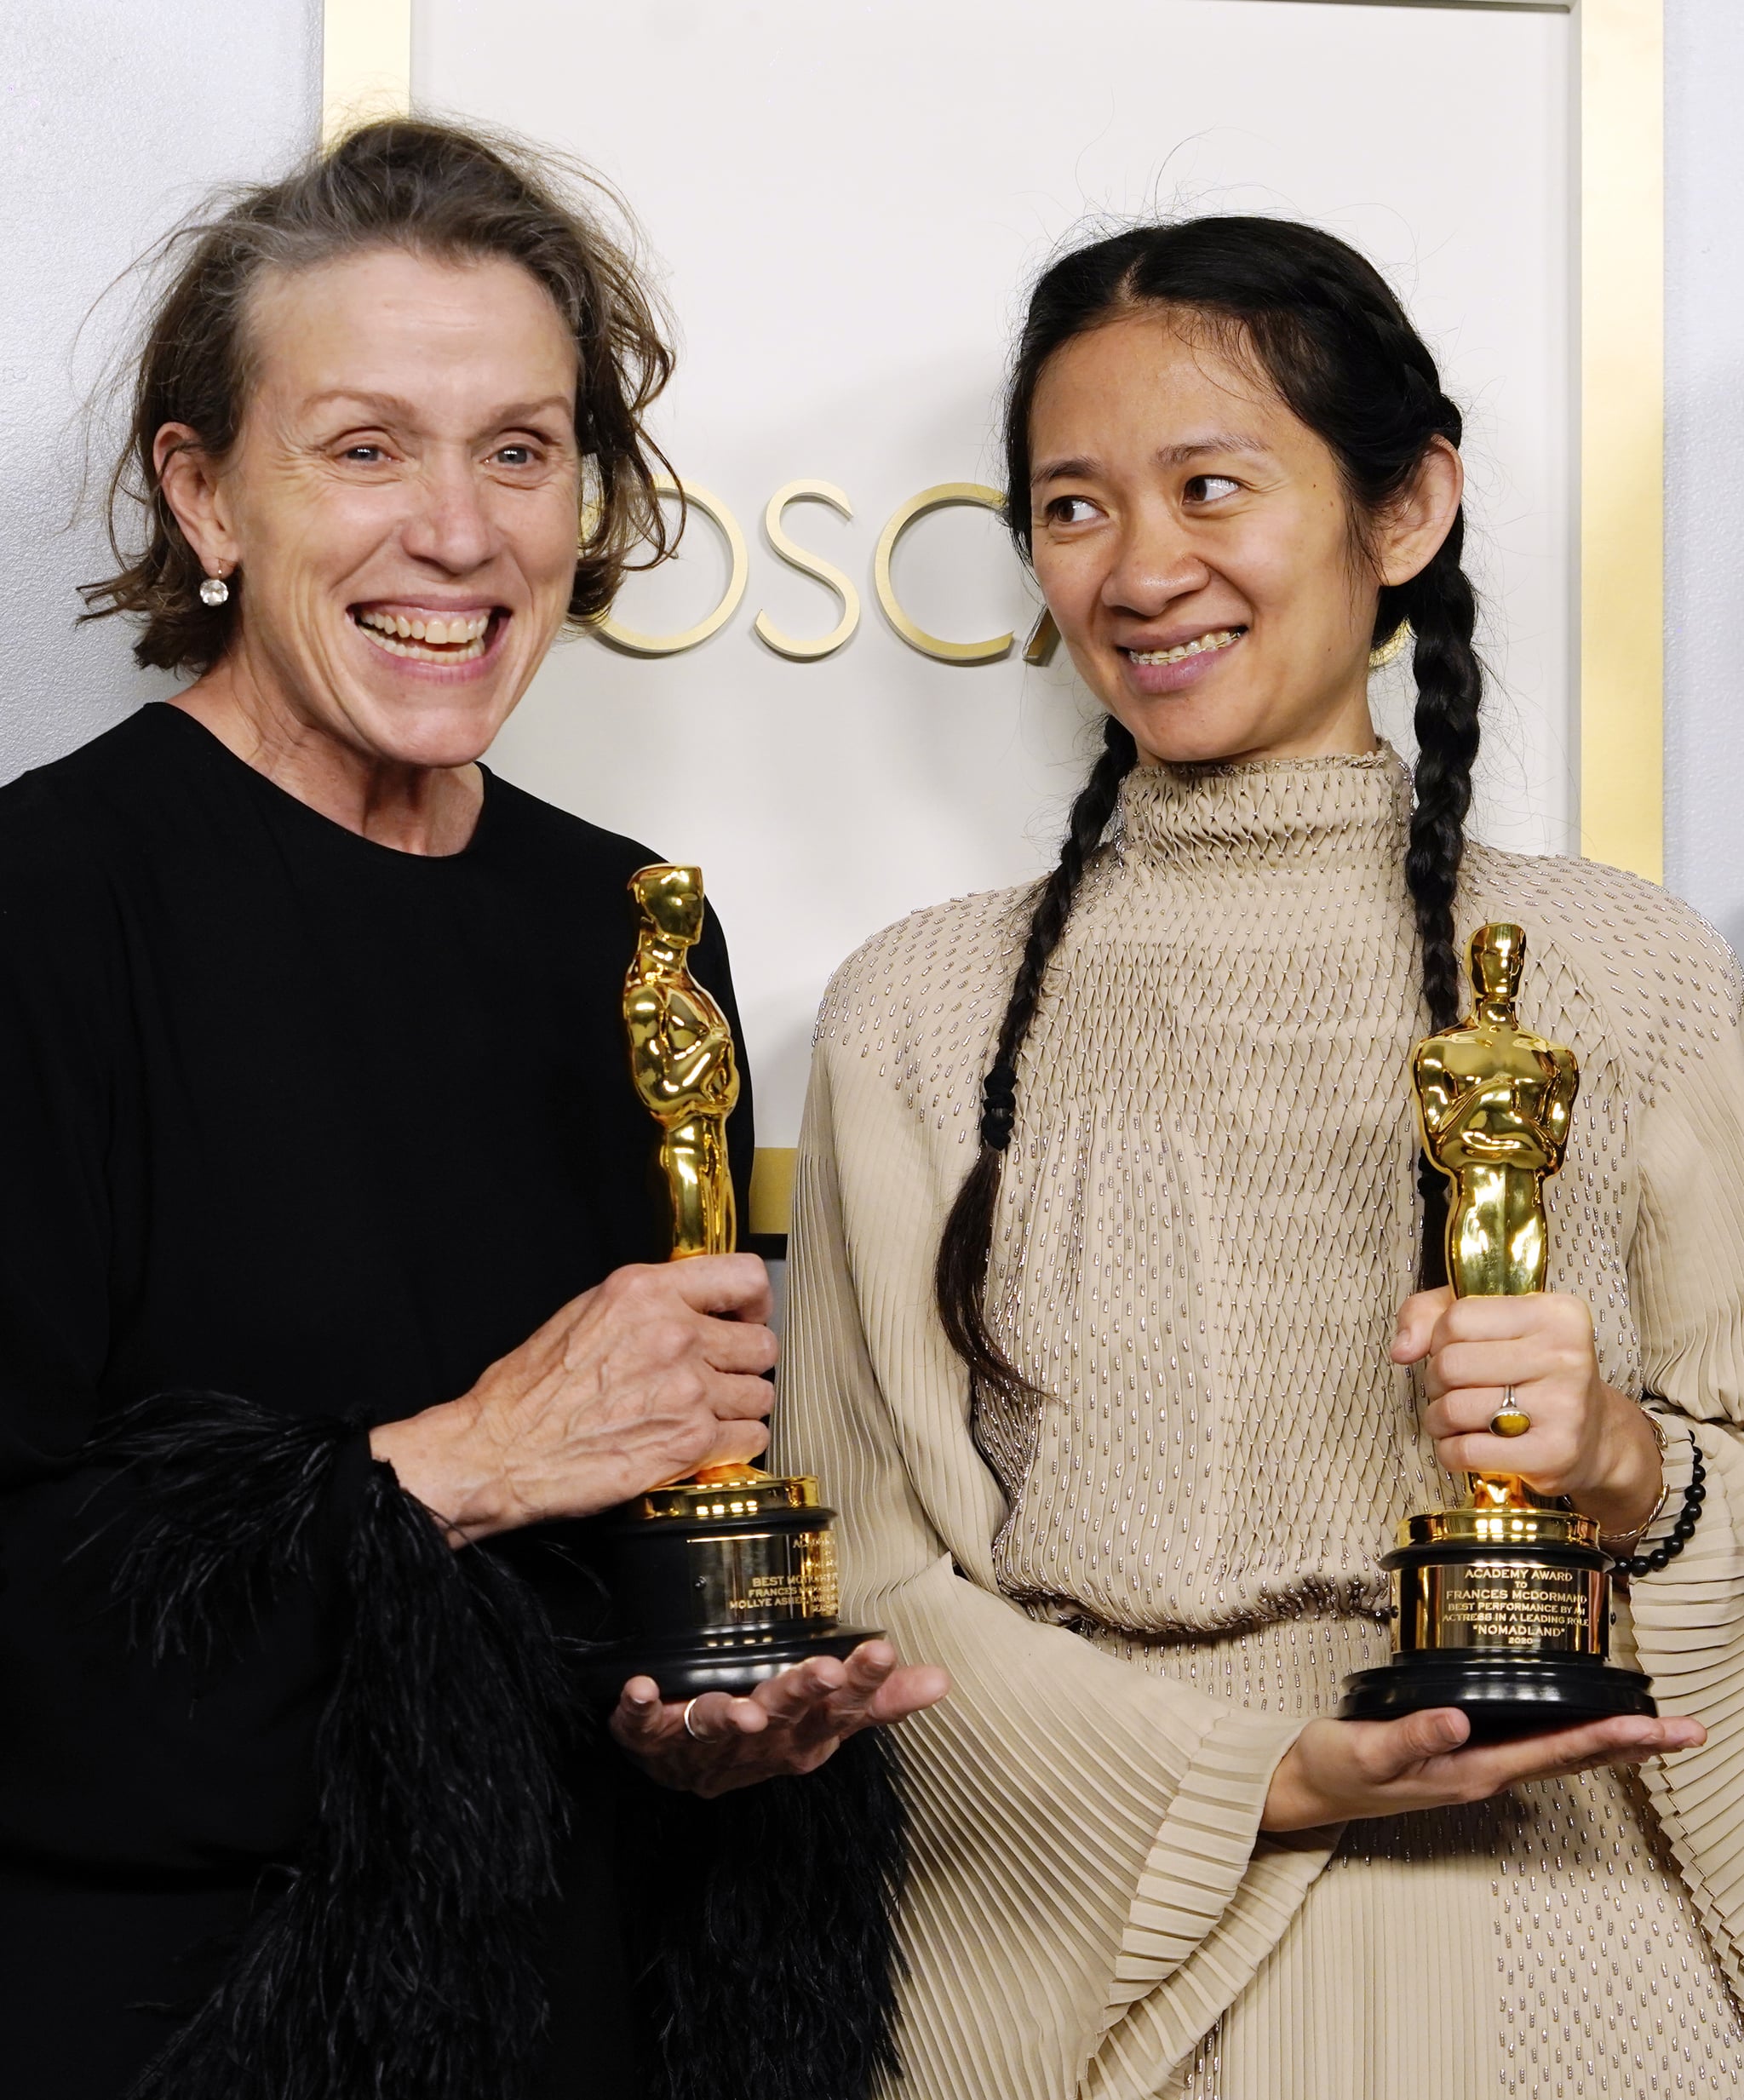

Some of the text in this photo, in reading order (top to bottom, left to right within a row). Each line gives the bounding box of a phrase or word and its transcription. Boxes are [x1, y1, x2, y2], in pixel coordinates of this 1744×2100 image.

[752, 1575, 784, 1587] BEST
[1465, 1569, 1573, 1581] ACADEMY AWARD
[1514, 1581, 1528, 1589] TO
[749, 1586, 798, 1598] FRANCES
[1446, 1589, 1508, 1600] FRANCES
[729, 1598, 772, 1609] MOLLYE
[1448, 1603, 1475, 1611] BEST
[1477, 1602, 1558, 1613] PERFORMANCE
[1442, 1612, 1589, 1627] ACTRESS IN A LEADING ROLE
[1472, 1625, 1565, 1637] "NOMADLAND"
